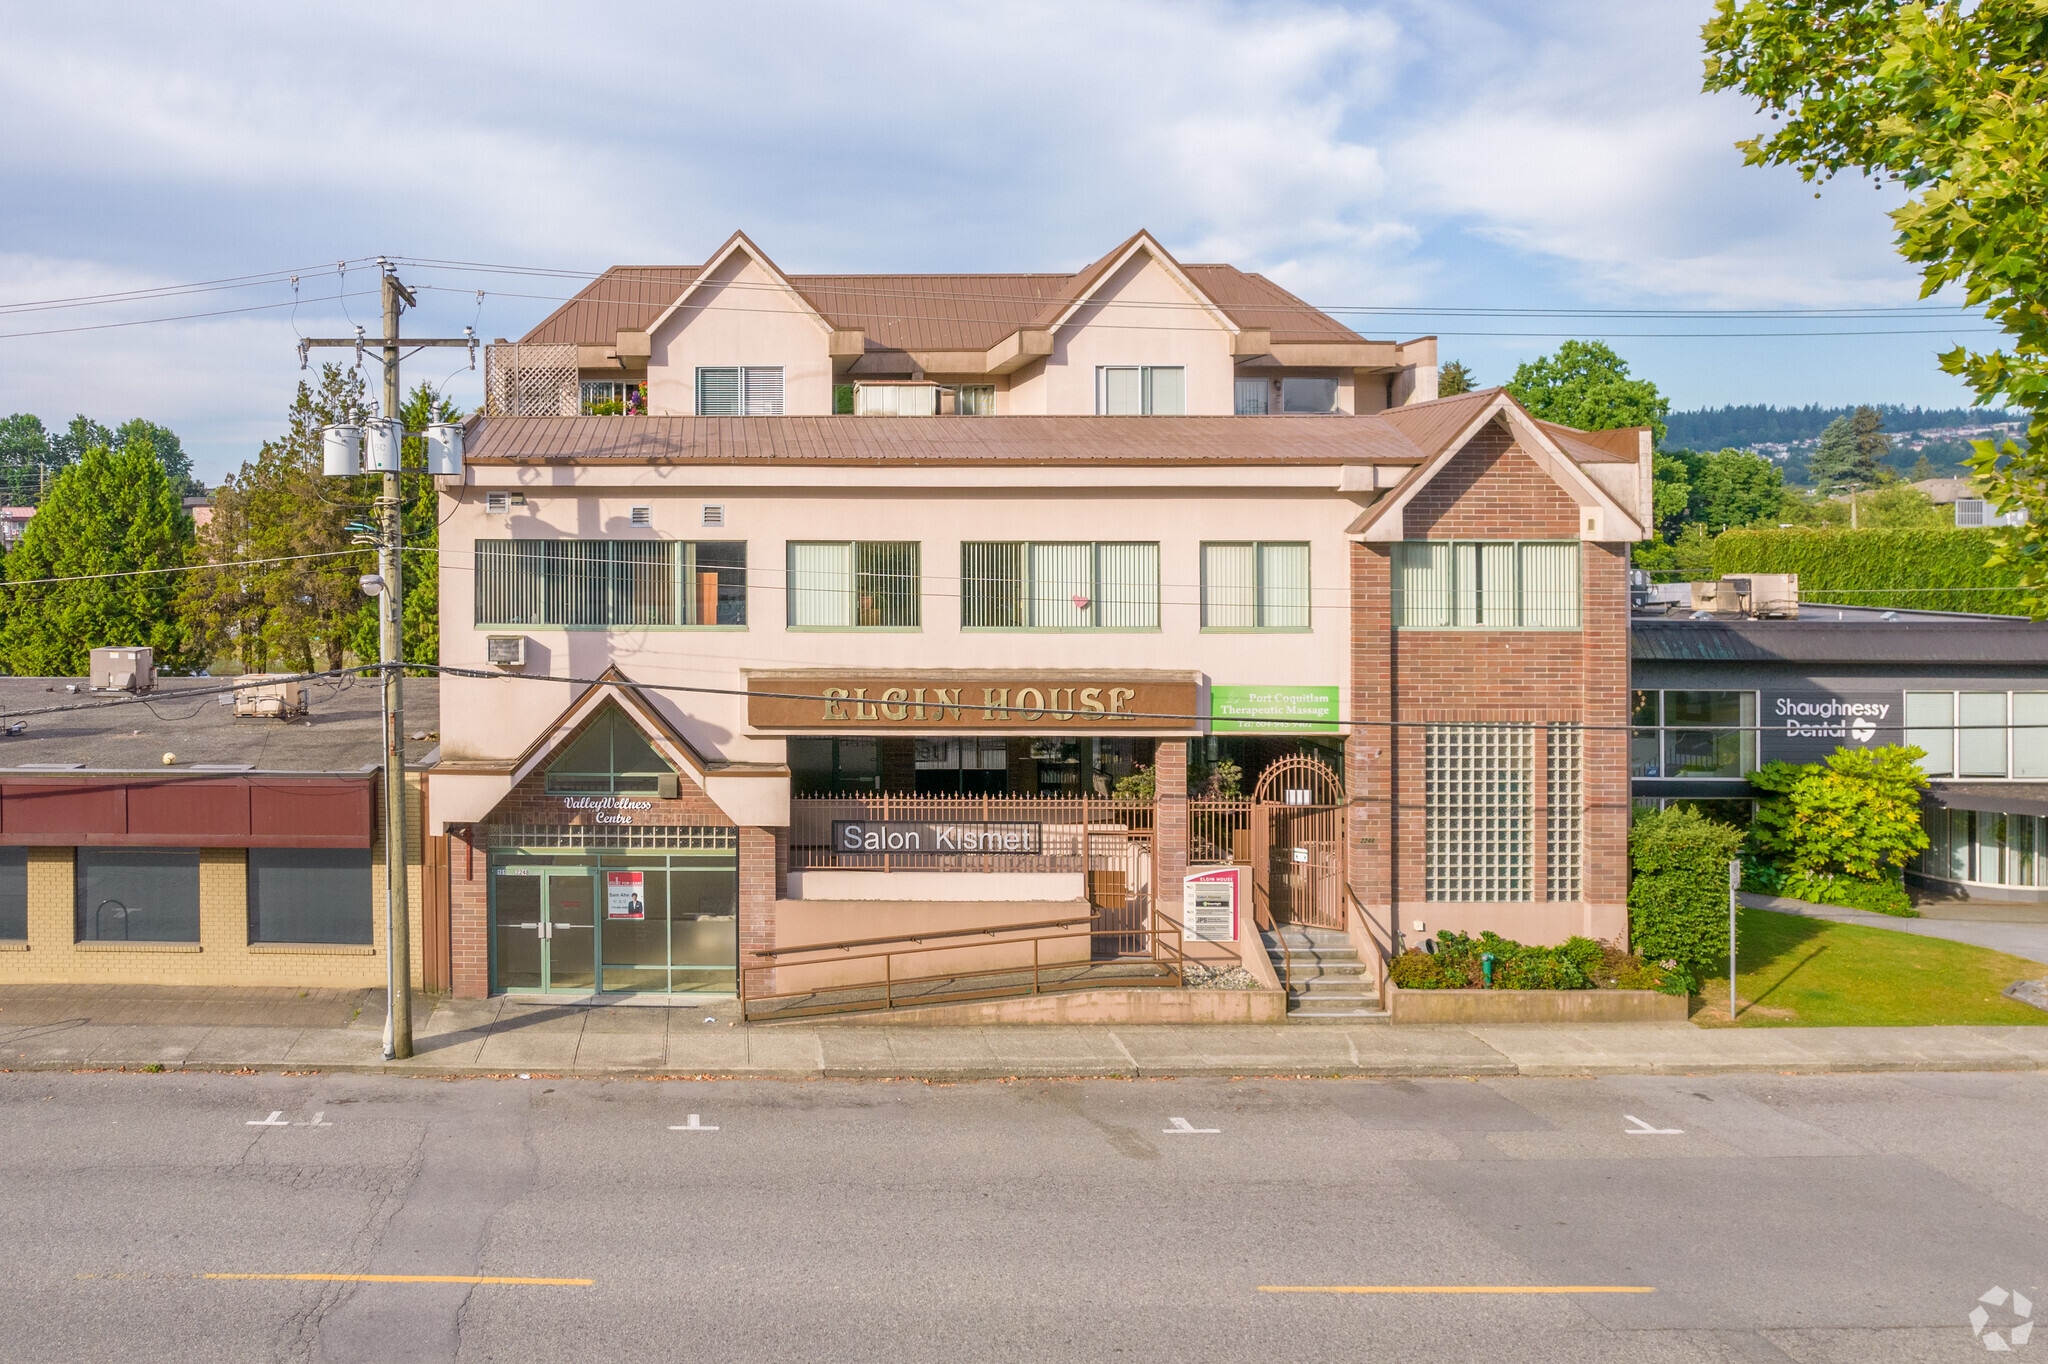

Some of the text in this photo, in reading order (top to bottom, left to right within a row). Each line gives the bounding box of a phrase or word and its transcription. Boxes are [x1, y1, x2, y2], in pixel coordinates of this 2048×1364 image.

[822, 688, 1136, 721] ELGIN HOUSE
[1249, 693, 1329, 705] Port Coquitlam
[1221, 705, 1329, 717] Therapeutic Massage
[1775, 698, 1890, 719] Shaughnessy
[1787, 719, 1846, 737] Dental
[596, 811, 633, 824] Centre
[843, 825, 1031, 850] Salon Kismet
